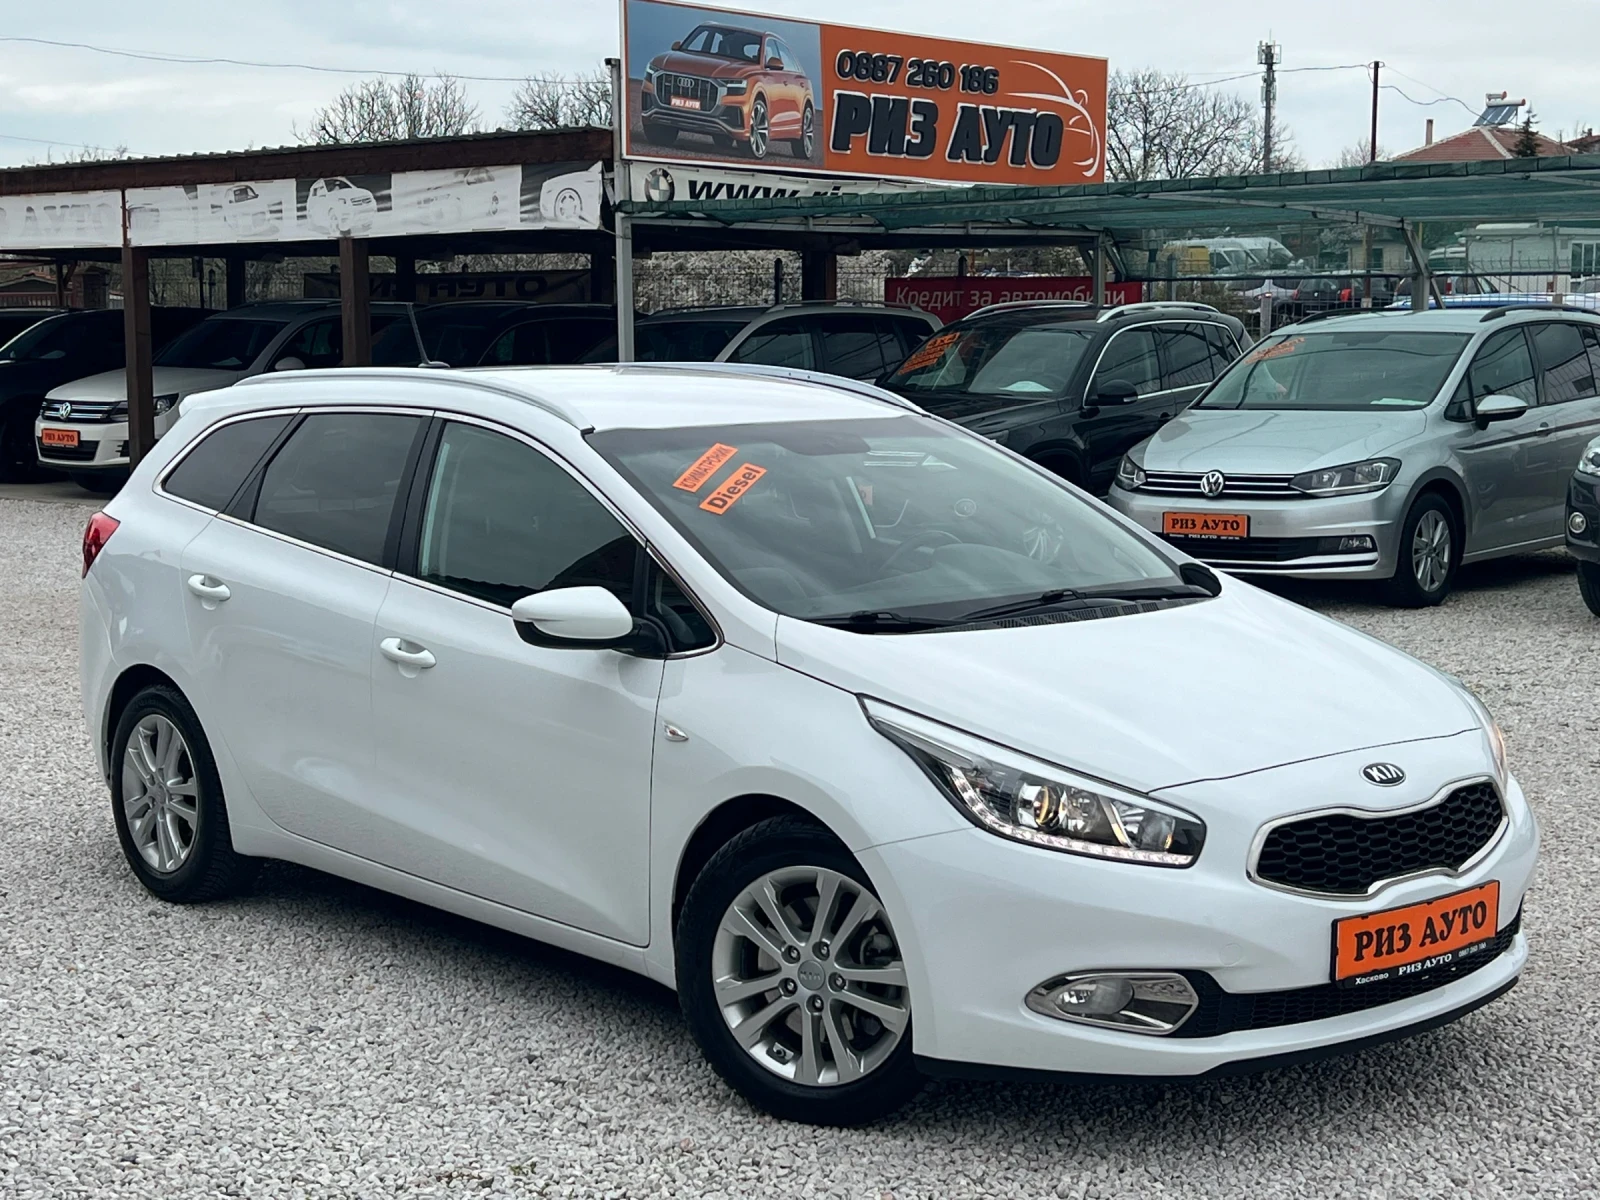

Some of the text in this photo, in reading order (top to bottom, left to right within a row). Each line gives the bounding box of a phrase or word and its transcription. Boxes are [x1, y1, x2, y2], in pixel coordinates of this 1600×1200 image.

[836, 49, 1000, 95] 0887 260 186
[830, 89, 1064, 170] РИЗ АУТО
[896, 286, 964, 311] Кредит
[968, 290, 993, 306] за
[707, 466, 761, 509] Diesel
[1171, 518, 1240, 531] РИЗ АУТО
[1365, 764, 1403, 782] KIA
[1354, 900, 1487, 962] РИЗ АУТО
[1355, 972, 1389, 985] Хасково
[1398, 962, 1422, 976] РИЗ
[1423, 953, 1452, 969] АУТО
